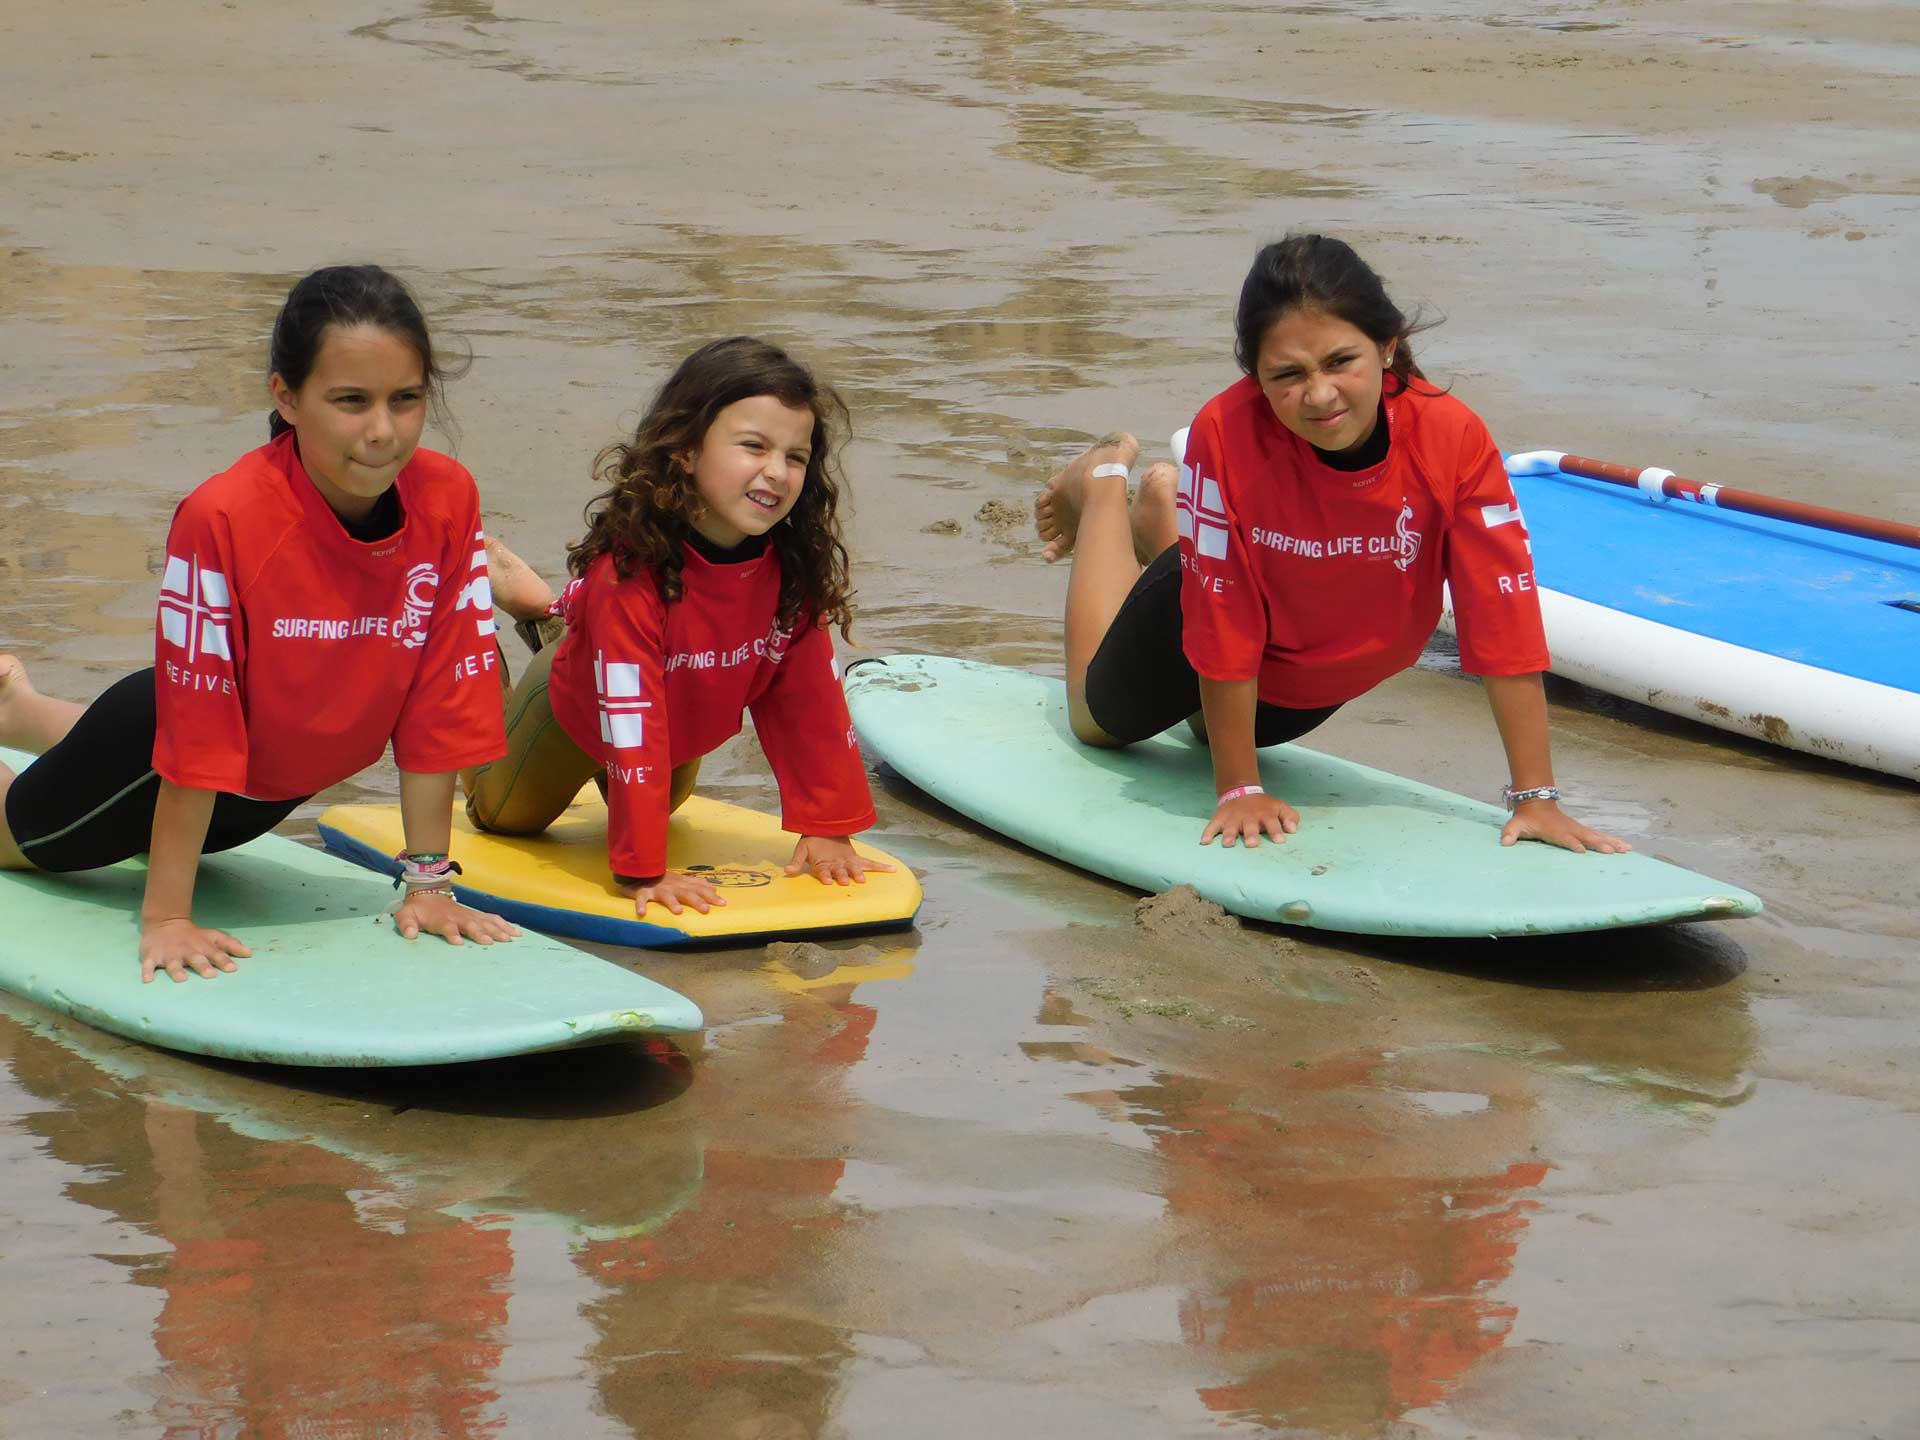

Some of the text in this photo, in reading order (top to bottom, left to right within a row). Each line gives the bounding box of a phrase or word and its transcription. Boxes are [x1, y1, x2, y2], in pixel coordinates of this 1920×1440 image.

[1252, 526, 1322, 558] SURFING
[1327, 537, 1363, 556] LIFE
[272, 618, 350, 639] SURFING
[352, 616, 389, 637] LIFE
[721, 641, 750, 667] LIFE
